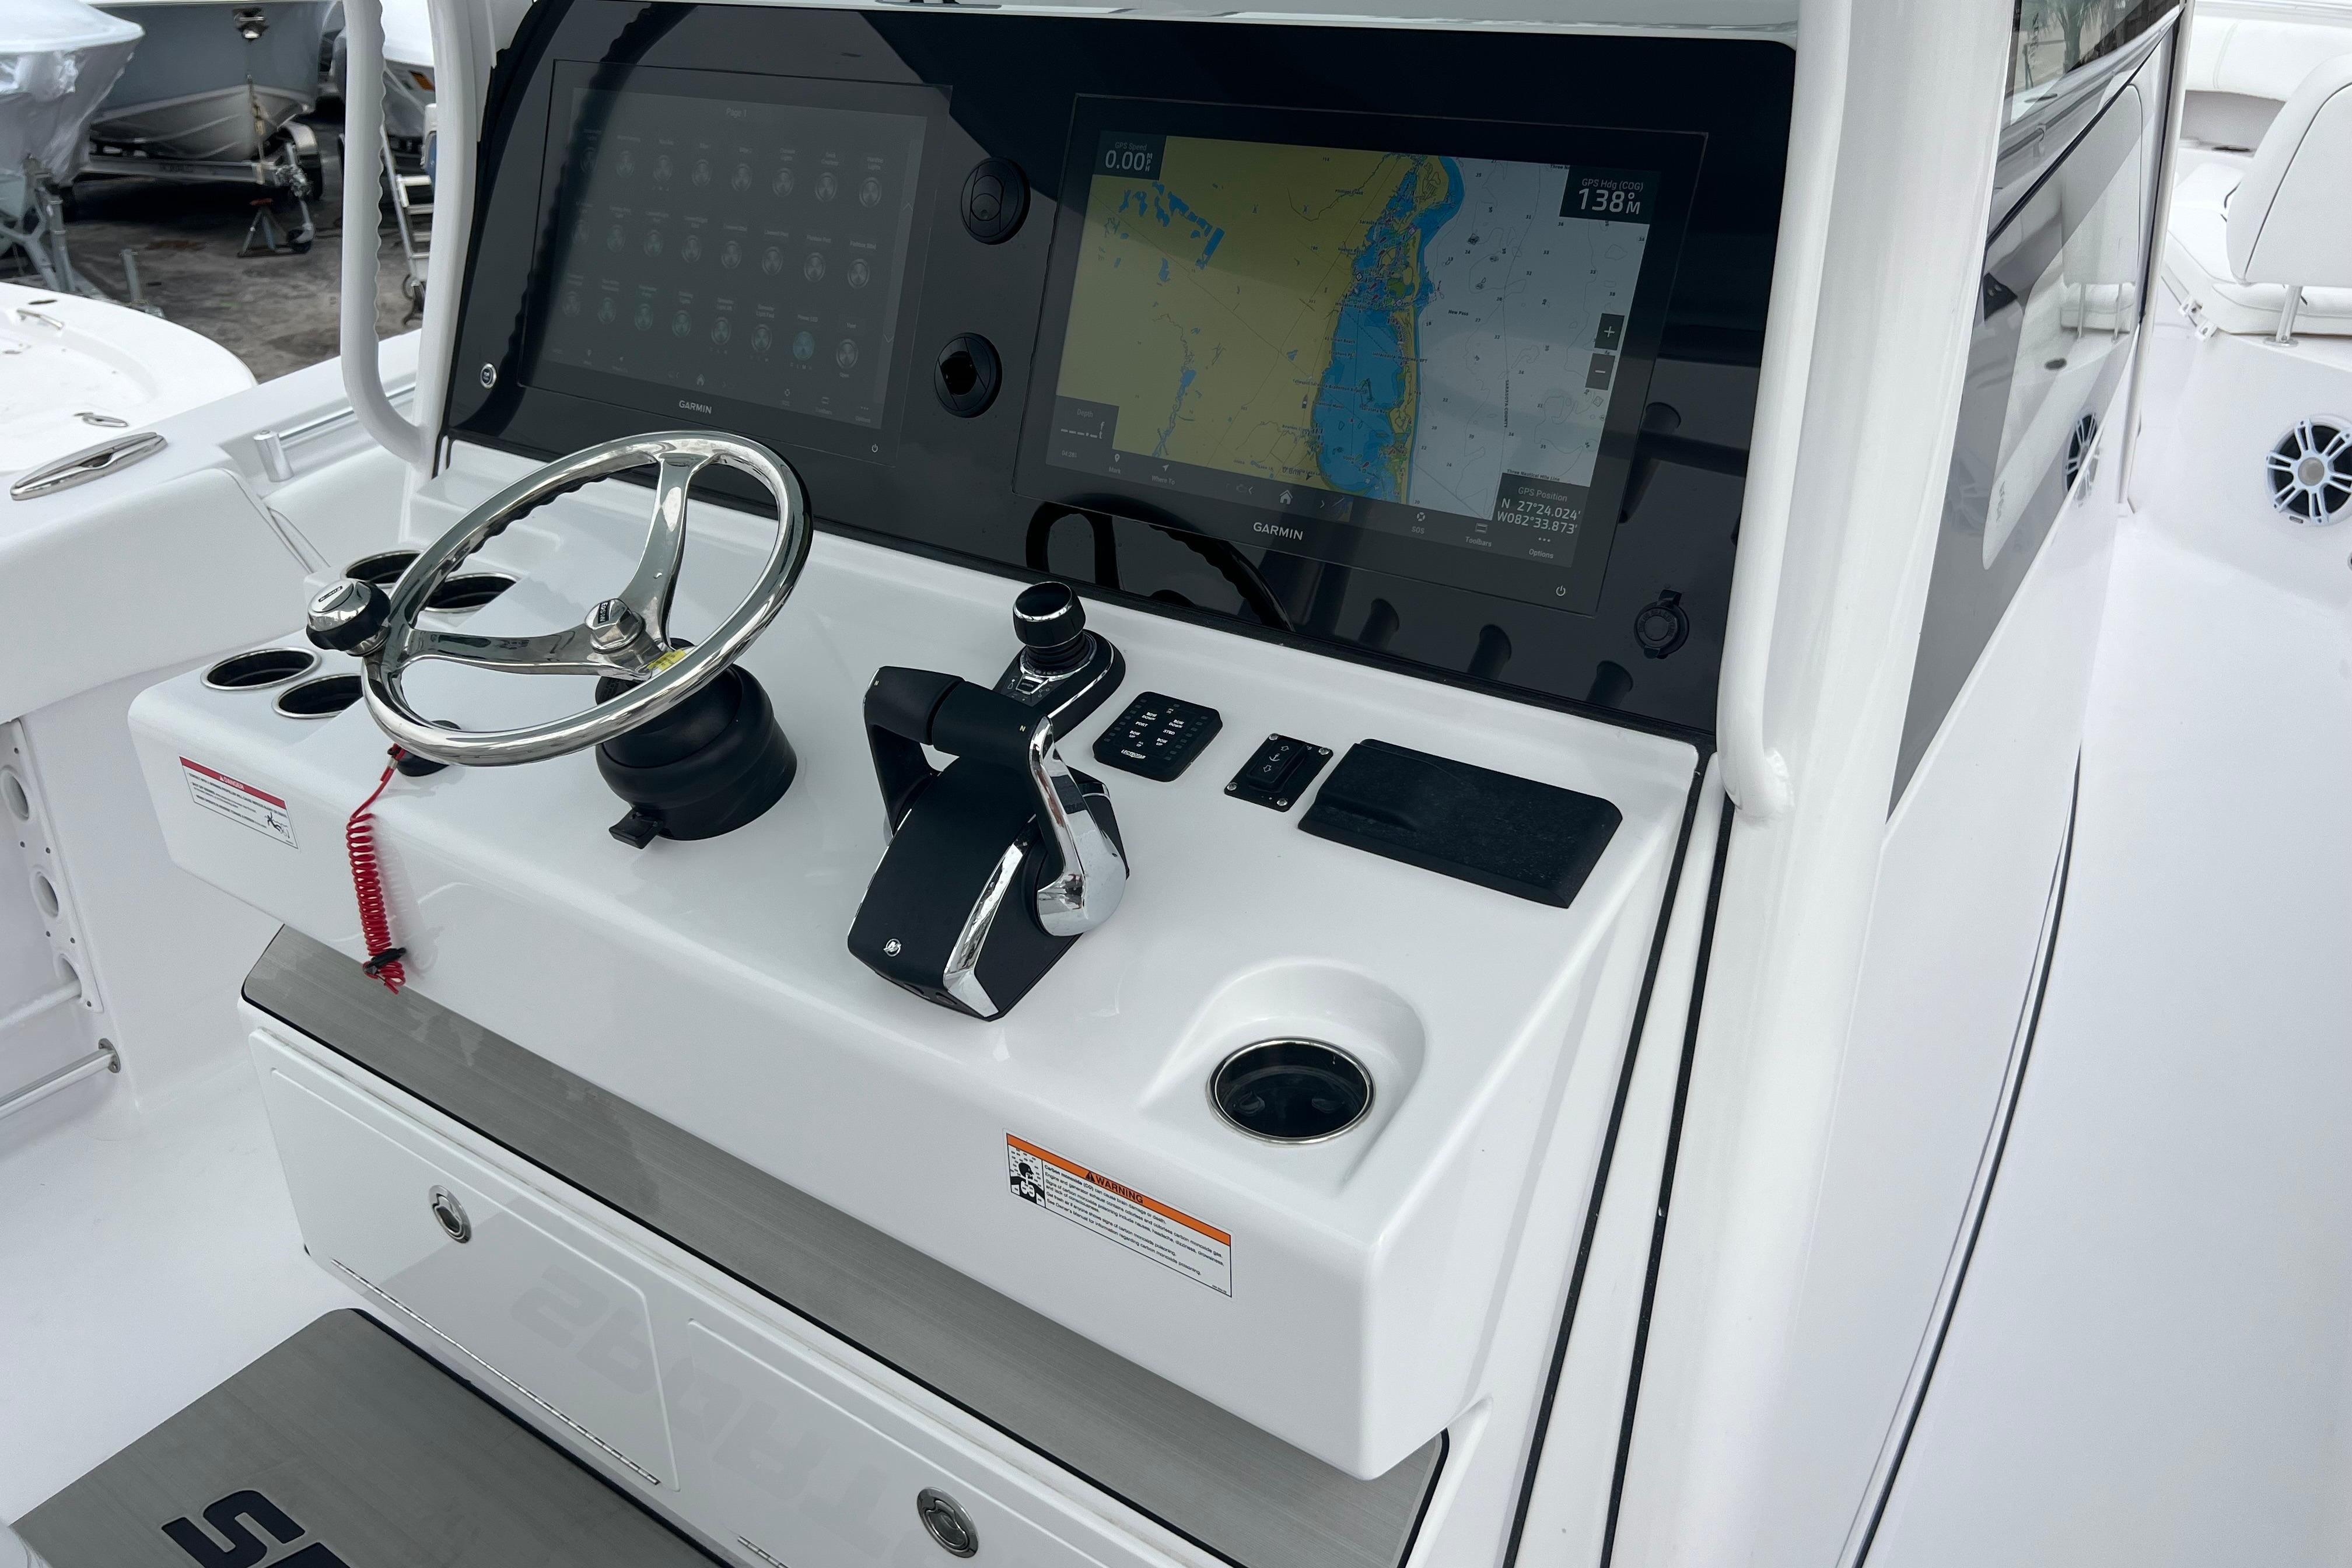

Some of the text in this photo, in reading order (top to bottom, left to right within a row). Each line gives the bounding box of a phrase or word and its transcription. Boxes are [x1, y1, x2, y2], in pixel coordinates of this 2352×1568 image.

[1115, 142, 1148, 151] GPS Speed
[1105, 150, 1145, 171] 0.00
[1581, 178, 1644, 192] GPS Hdg (COG)
[678, 400, 712, 414] GARMIN
[1077, 408, 1094, 418] Depth
[1109, 466, 1121, 474] Mark
[1152, 475, 1176, 486] Where To
[1518, 486, 1568, 502] GPS Position
[1502, 498, 1511, 509] N
[1253, 522, 1304, 540] GARMIN
[1411, 526, 1425, 534] SOS
[1465, 536, 1493, 547] Toolbars
[1528, 548, 1555, 560] Options
[1096, 1175, 1144, 1204] WARNING
